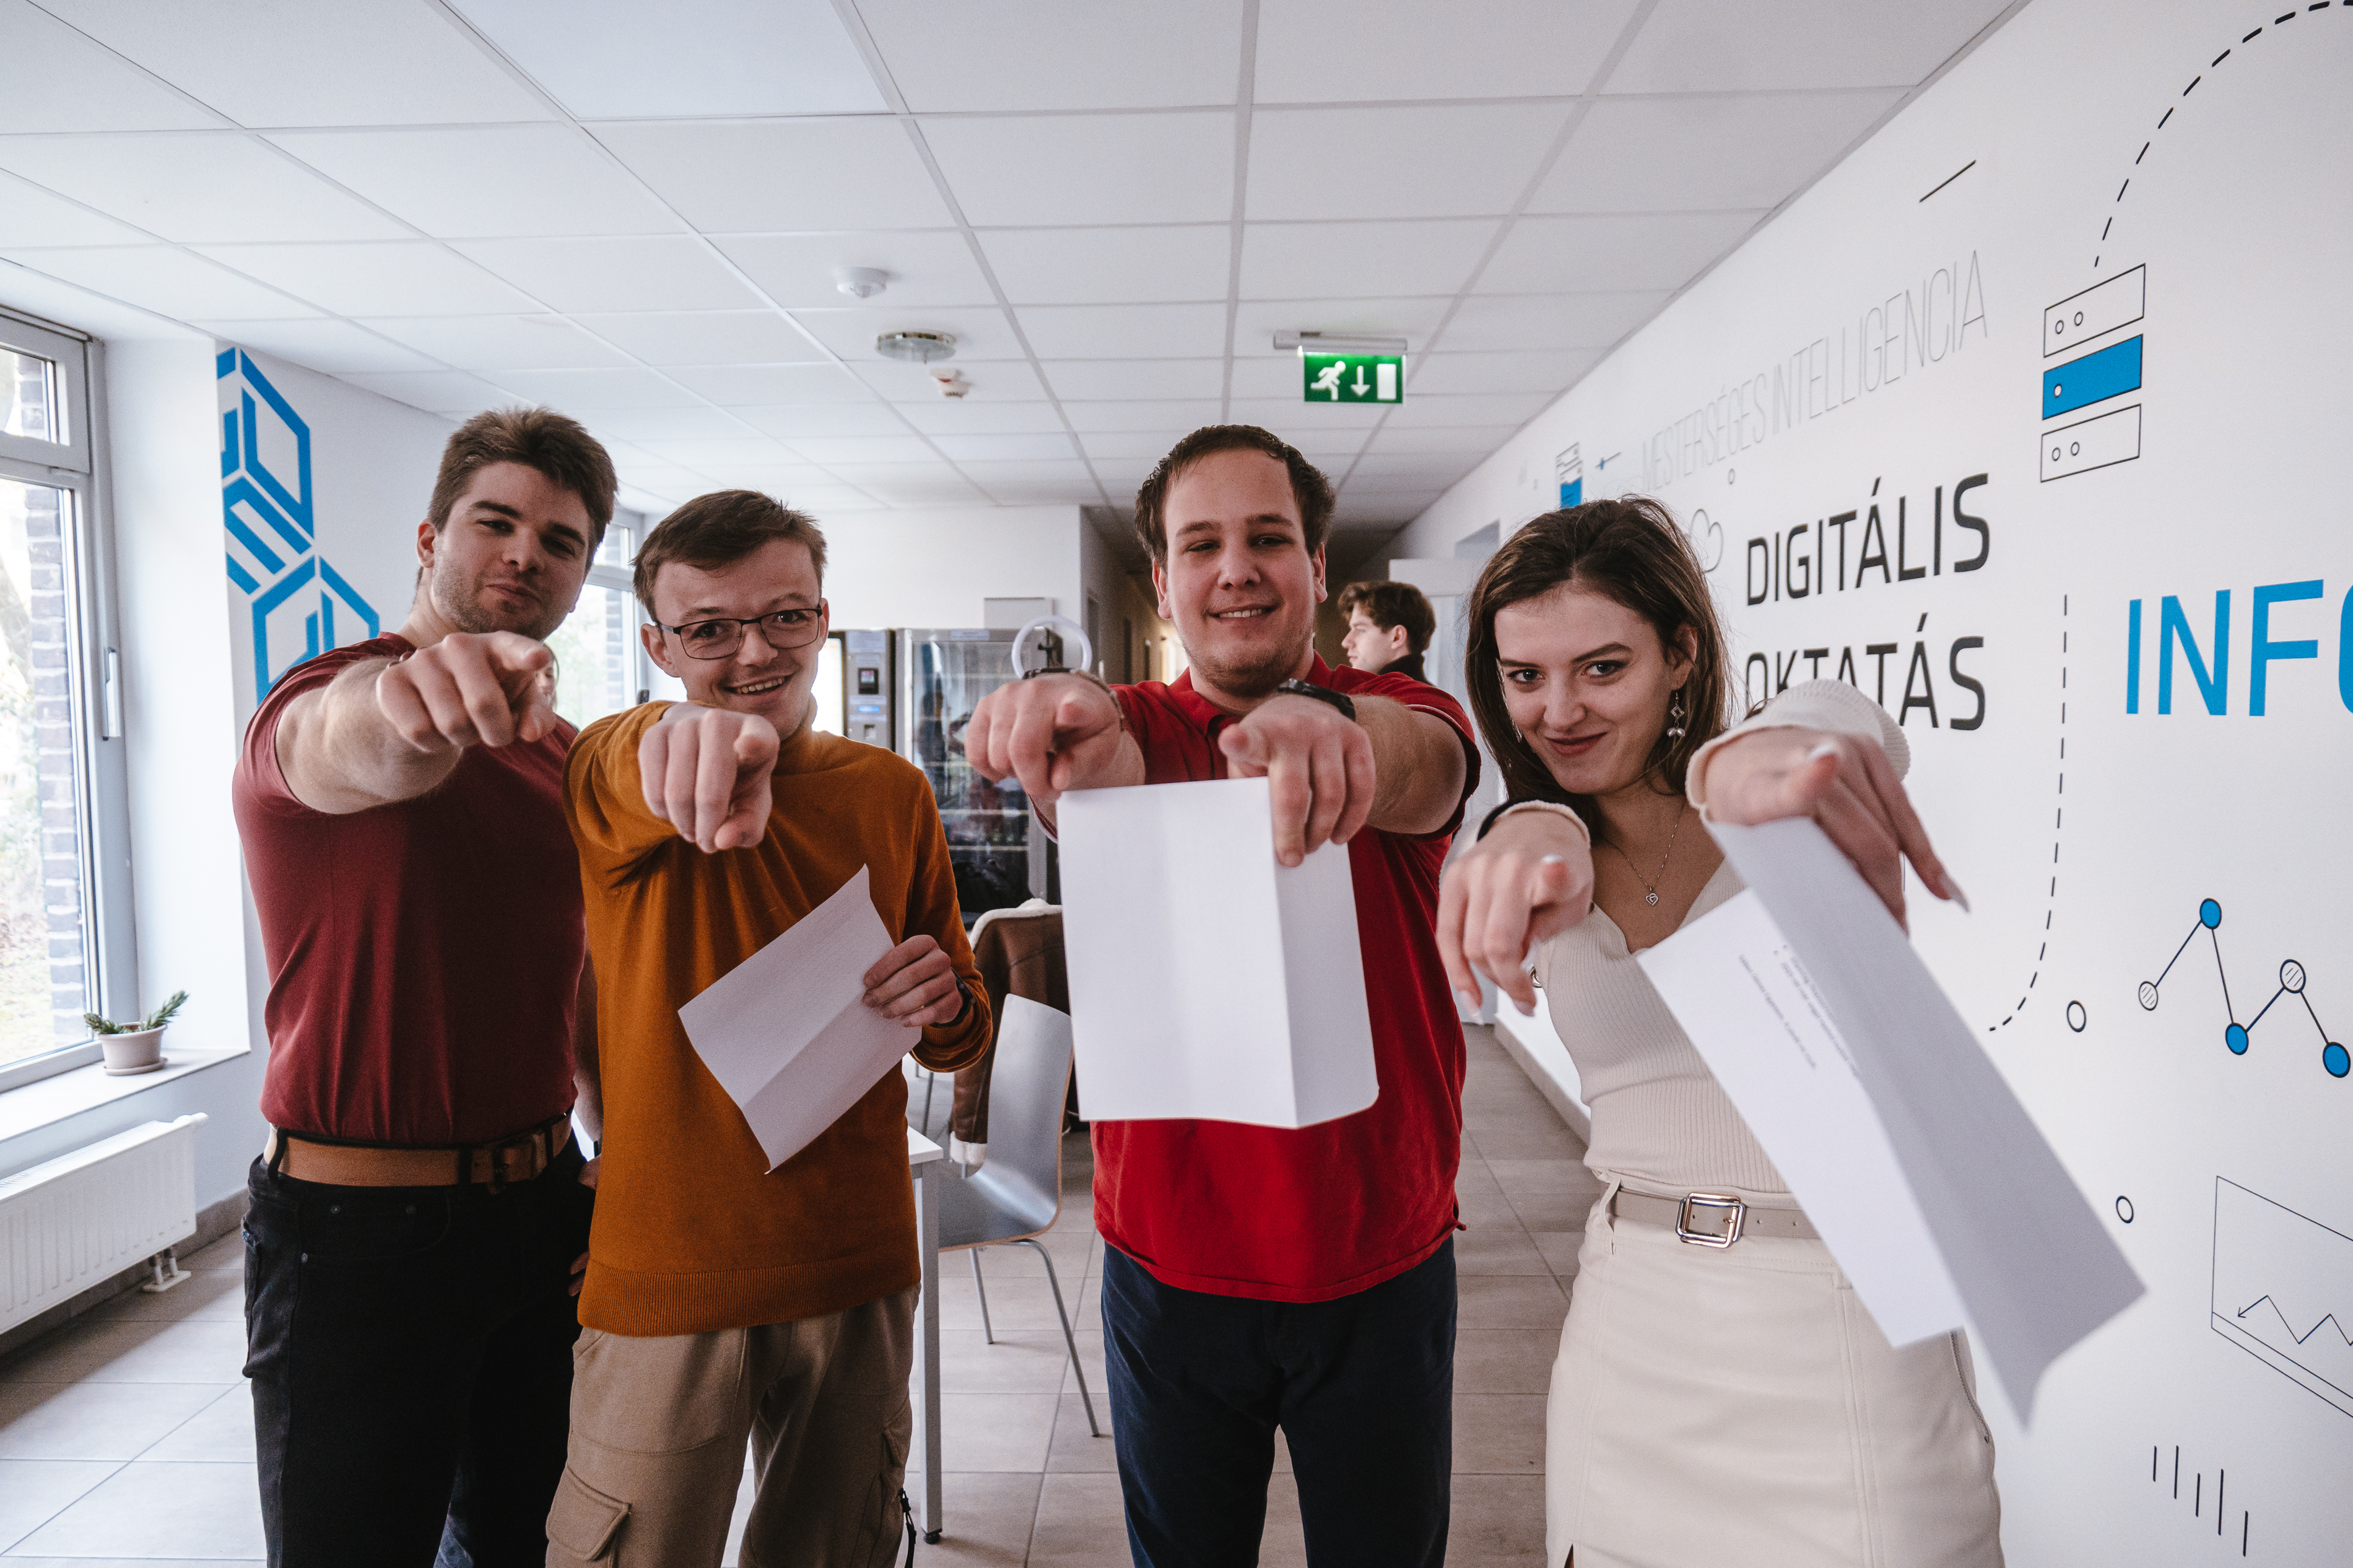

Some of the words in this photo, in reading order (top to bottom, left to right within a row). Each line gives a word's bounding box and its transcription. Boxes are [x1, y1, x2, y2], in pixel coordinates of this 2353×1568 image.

[1773, 249, 1987, 435] INTELLIGENCIA
[1747, 473, 1990, 606] DIGITÁLIS
[2126, 579, 2353, 716] INF
